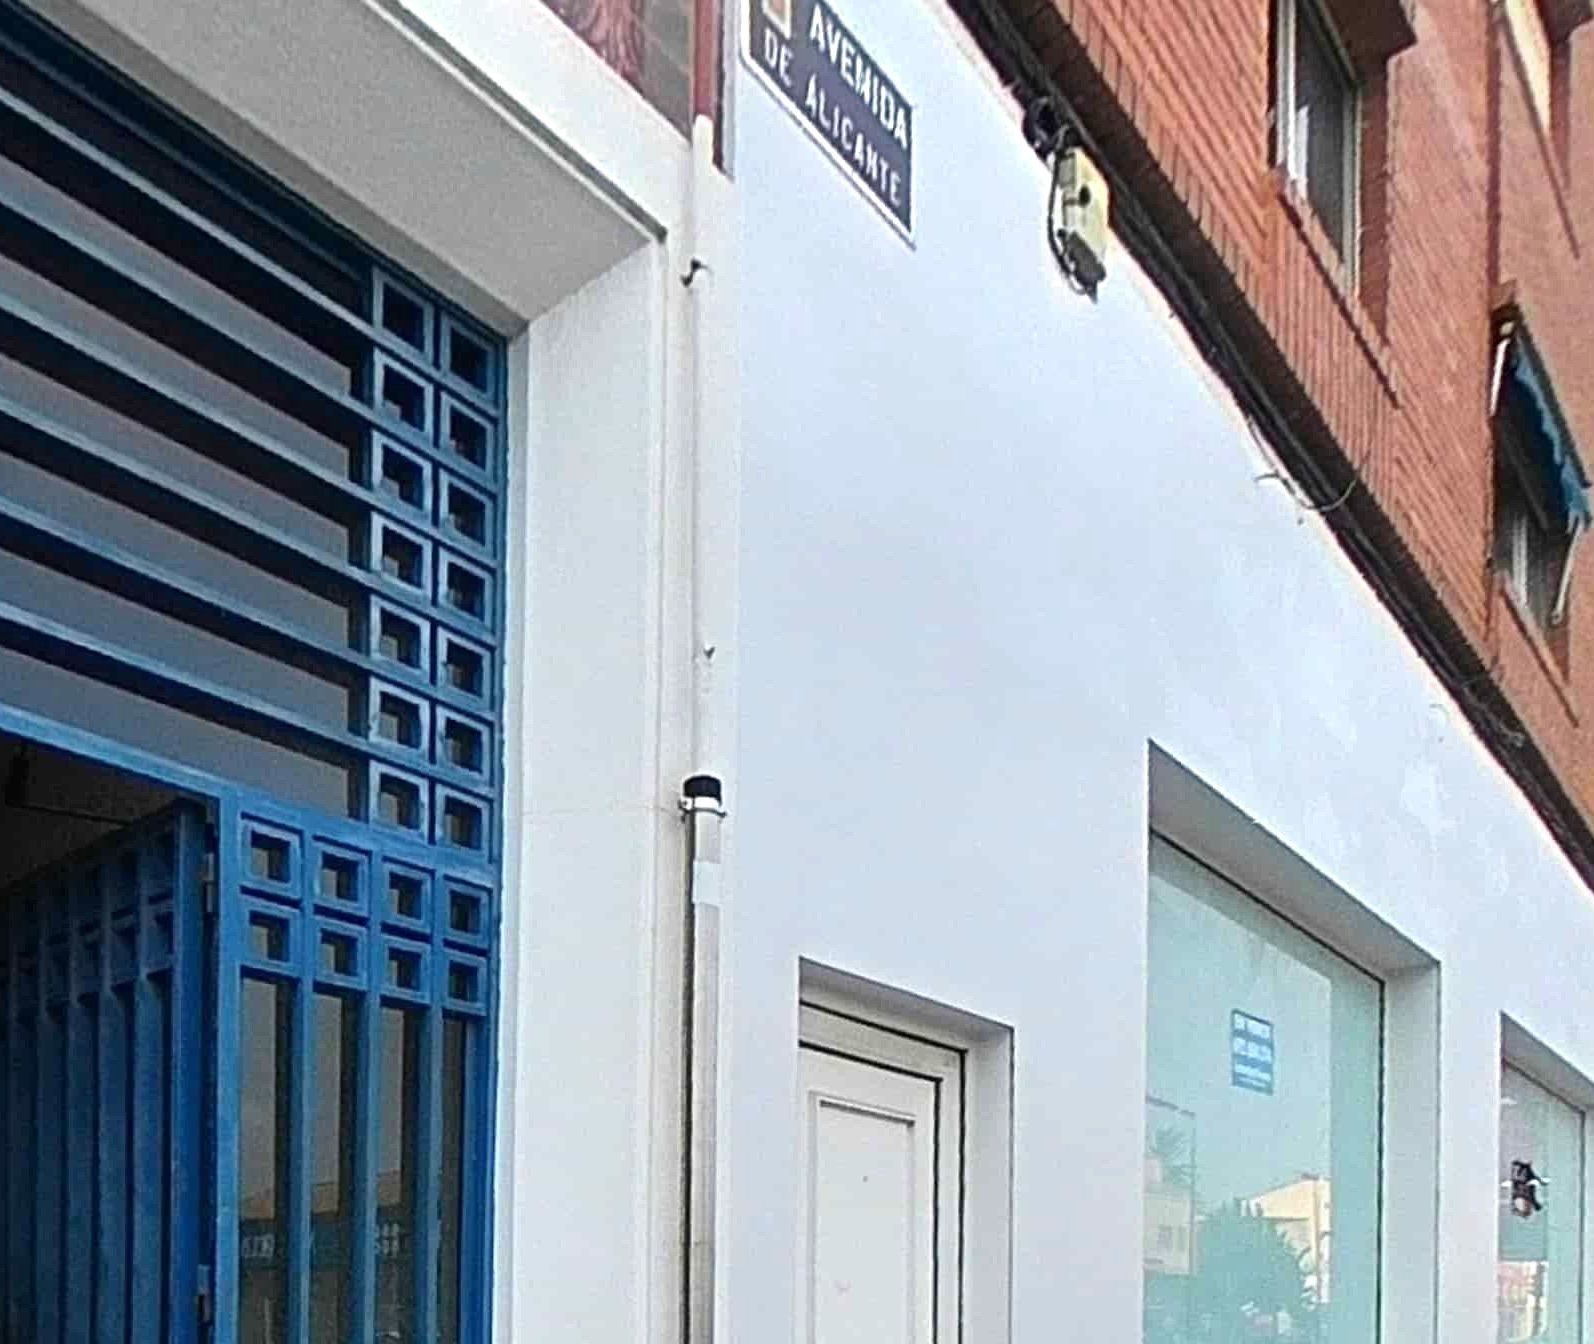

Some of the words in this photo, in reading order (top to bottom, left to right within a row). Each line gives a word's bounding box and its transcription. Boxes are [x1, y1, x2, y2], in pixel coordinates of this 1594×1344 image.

[764, 27, 792, 87] DE
[805, 74, 902, 207] ALICANTE
[810, 3, 907, 149] AVENIDA
